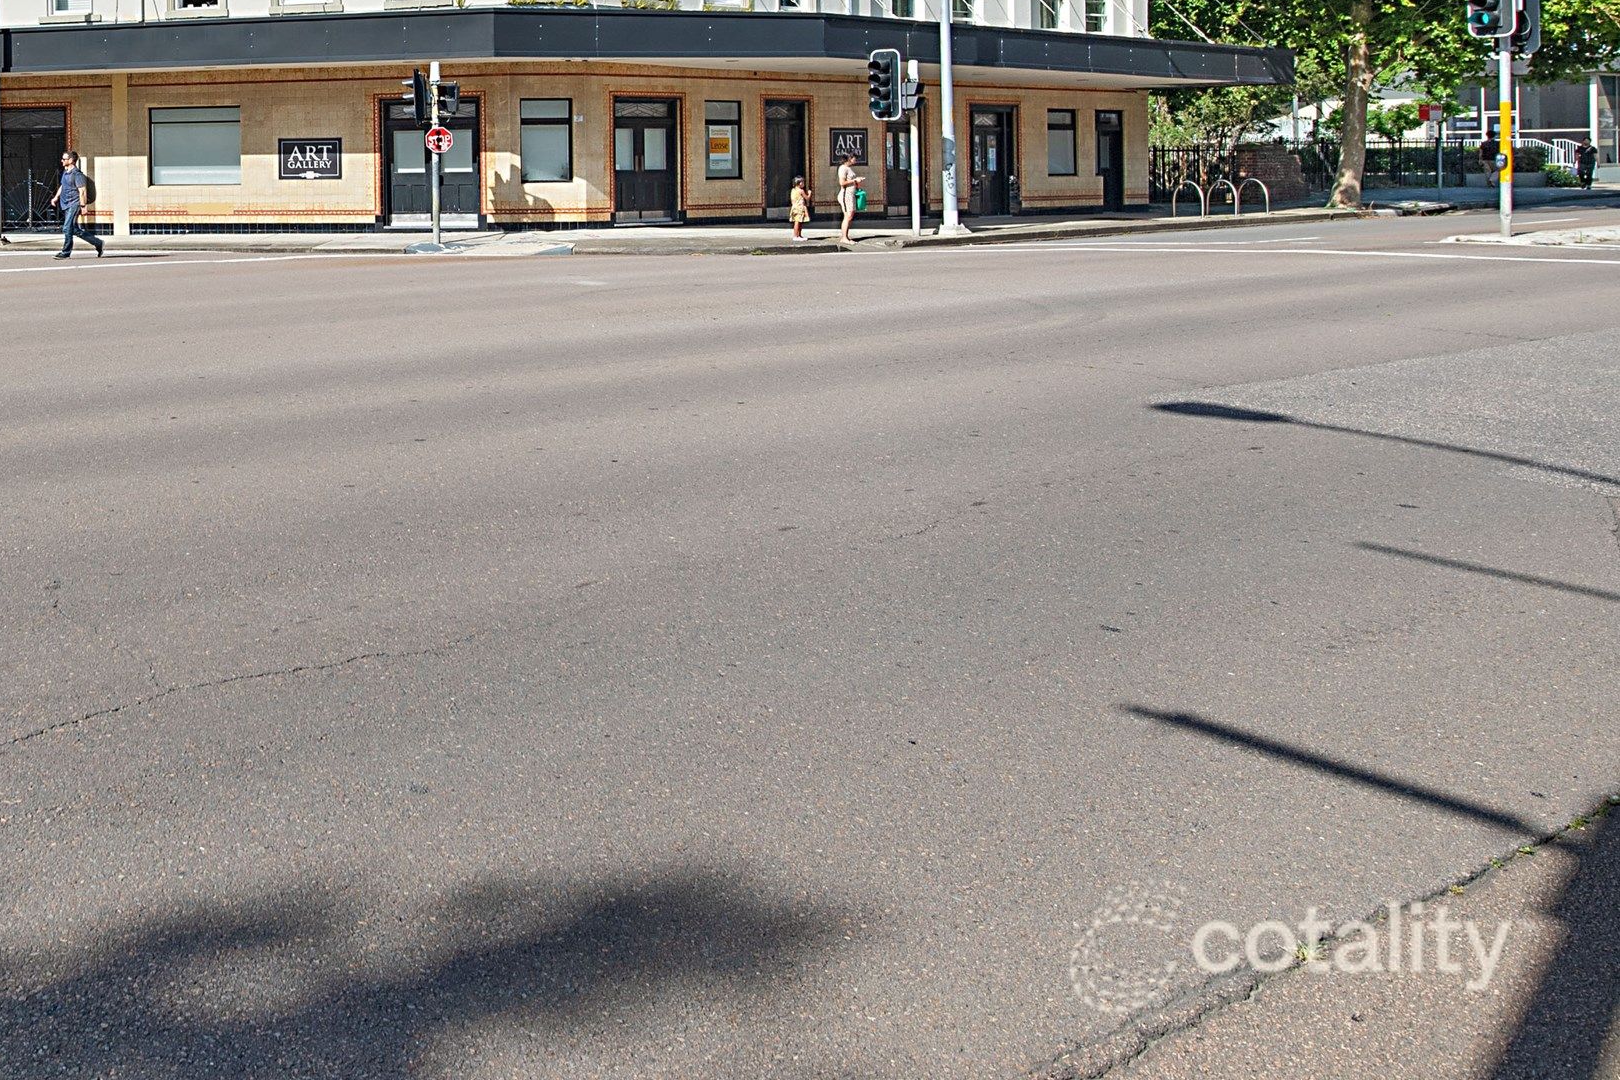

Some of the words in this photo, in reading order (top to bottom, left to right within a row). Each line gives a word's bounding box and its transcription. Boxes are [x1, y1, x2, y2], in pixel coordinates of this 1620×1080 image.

[427, 134, 450, 146] STOP
[836, 134, 863, 149] ART
[288, 145, 332, 161] ART
[287, 160, 332, 169] GALLERY
